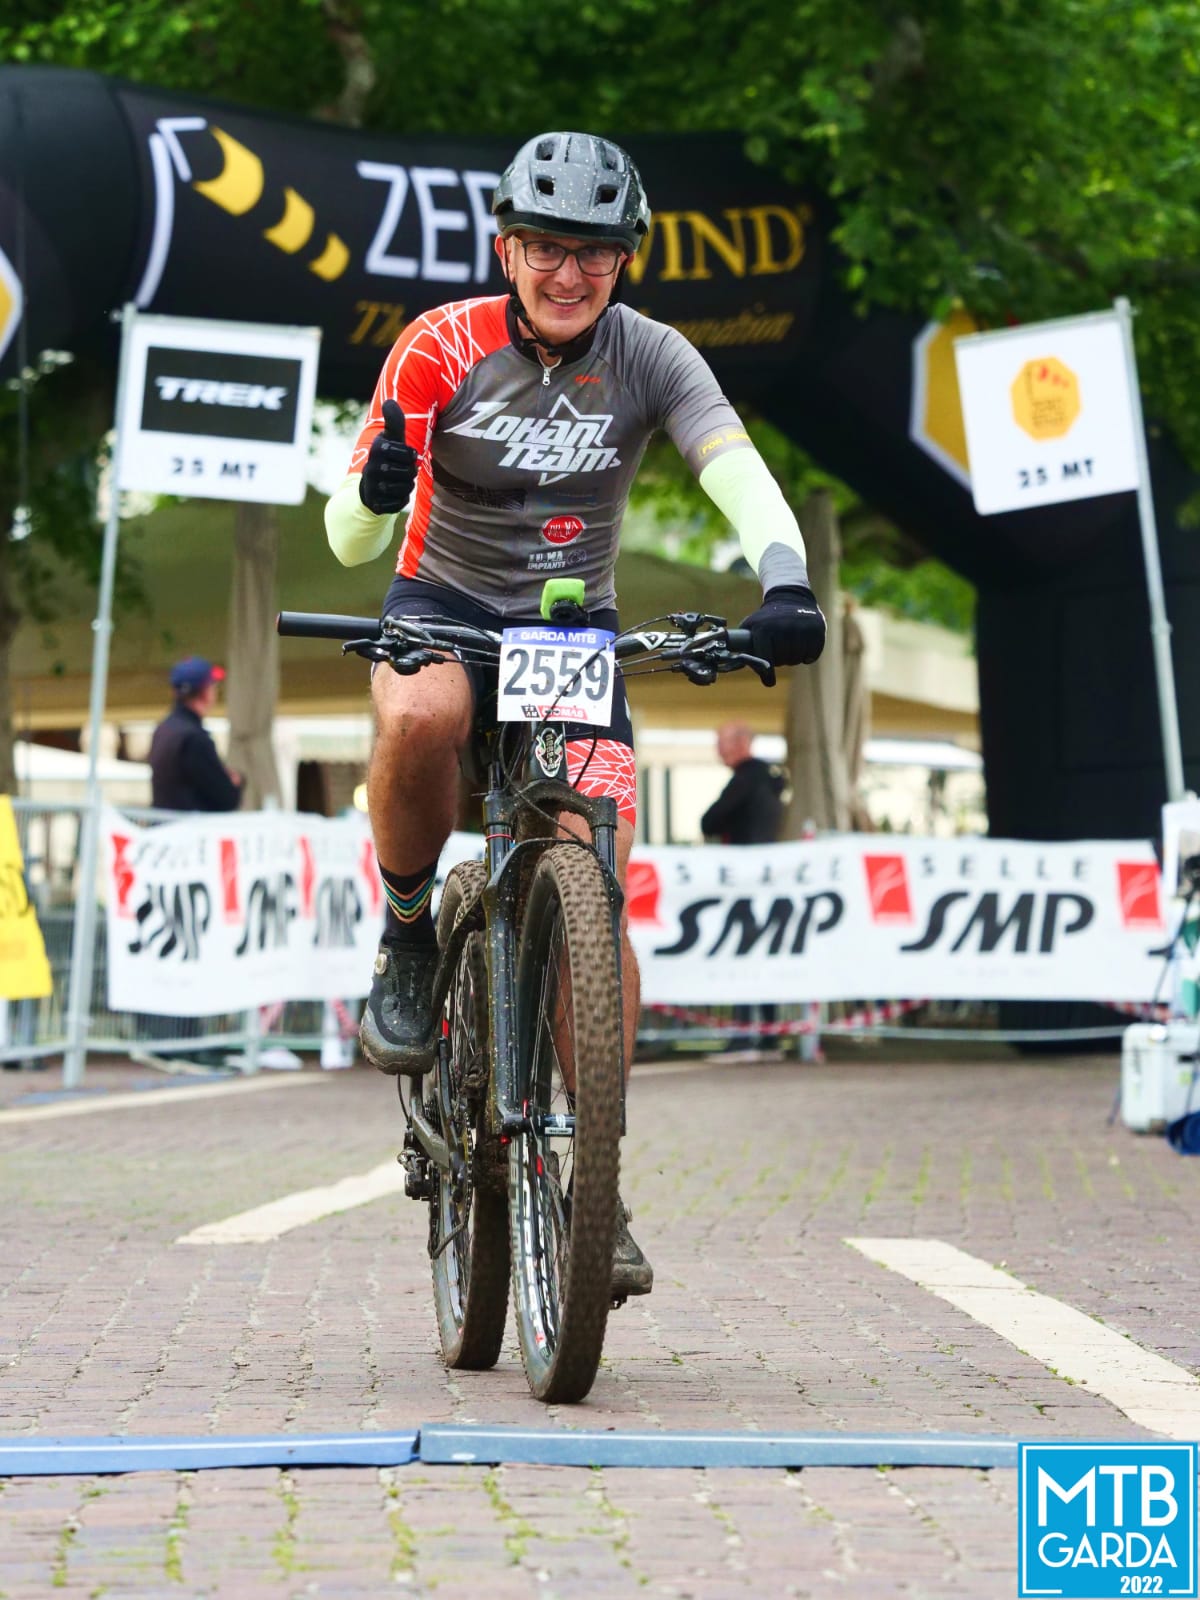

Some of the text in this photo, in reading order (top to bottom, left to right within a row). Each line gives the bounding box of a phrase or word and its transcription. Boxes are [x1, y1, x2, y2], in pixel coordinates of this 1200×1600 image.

[155, 376, 287, 410] TREK
[1061, 457, 1092, 480] MT
[521, 631, 598, 644] GARDA MTB
[503, 648, 610, 701] 2559
[920, 854, 1089, 882] SELLE
[653, 890, 845, 957] SMP
[900, 889, 1096, 954] SMP
